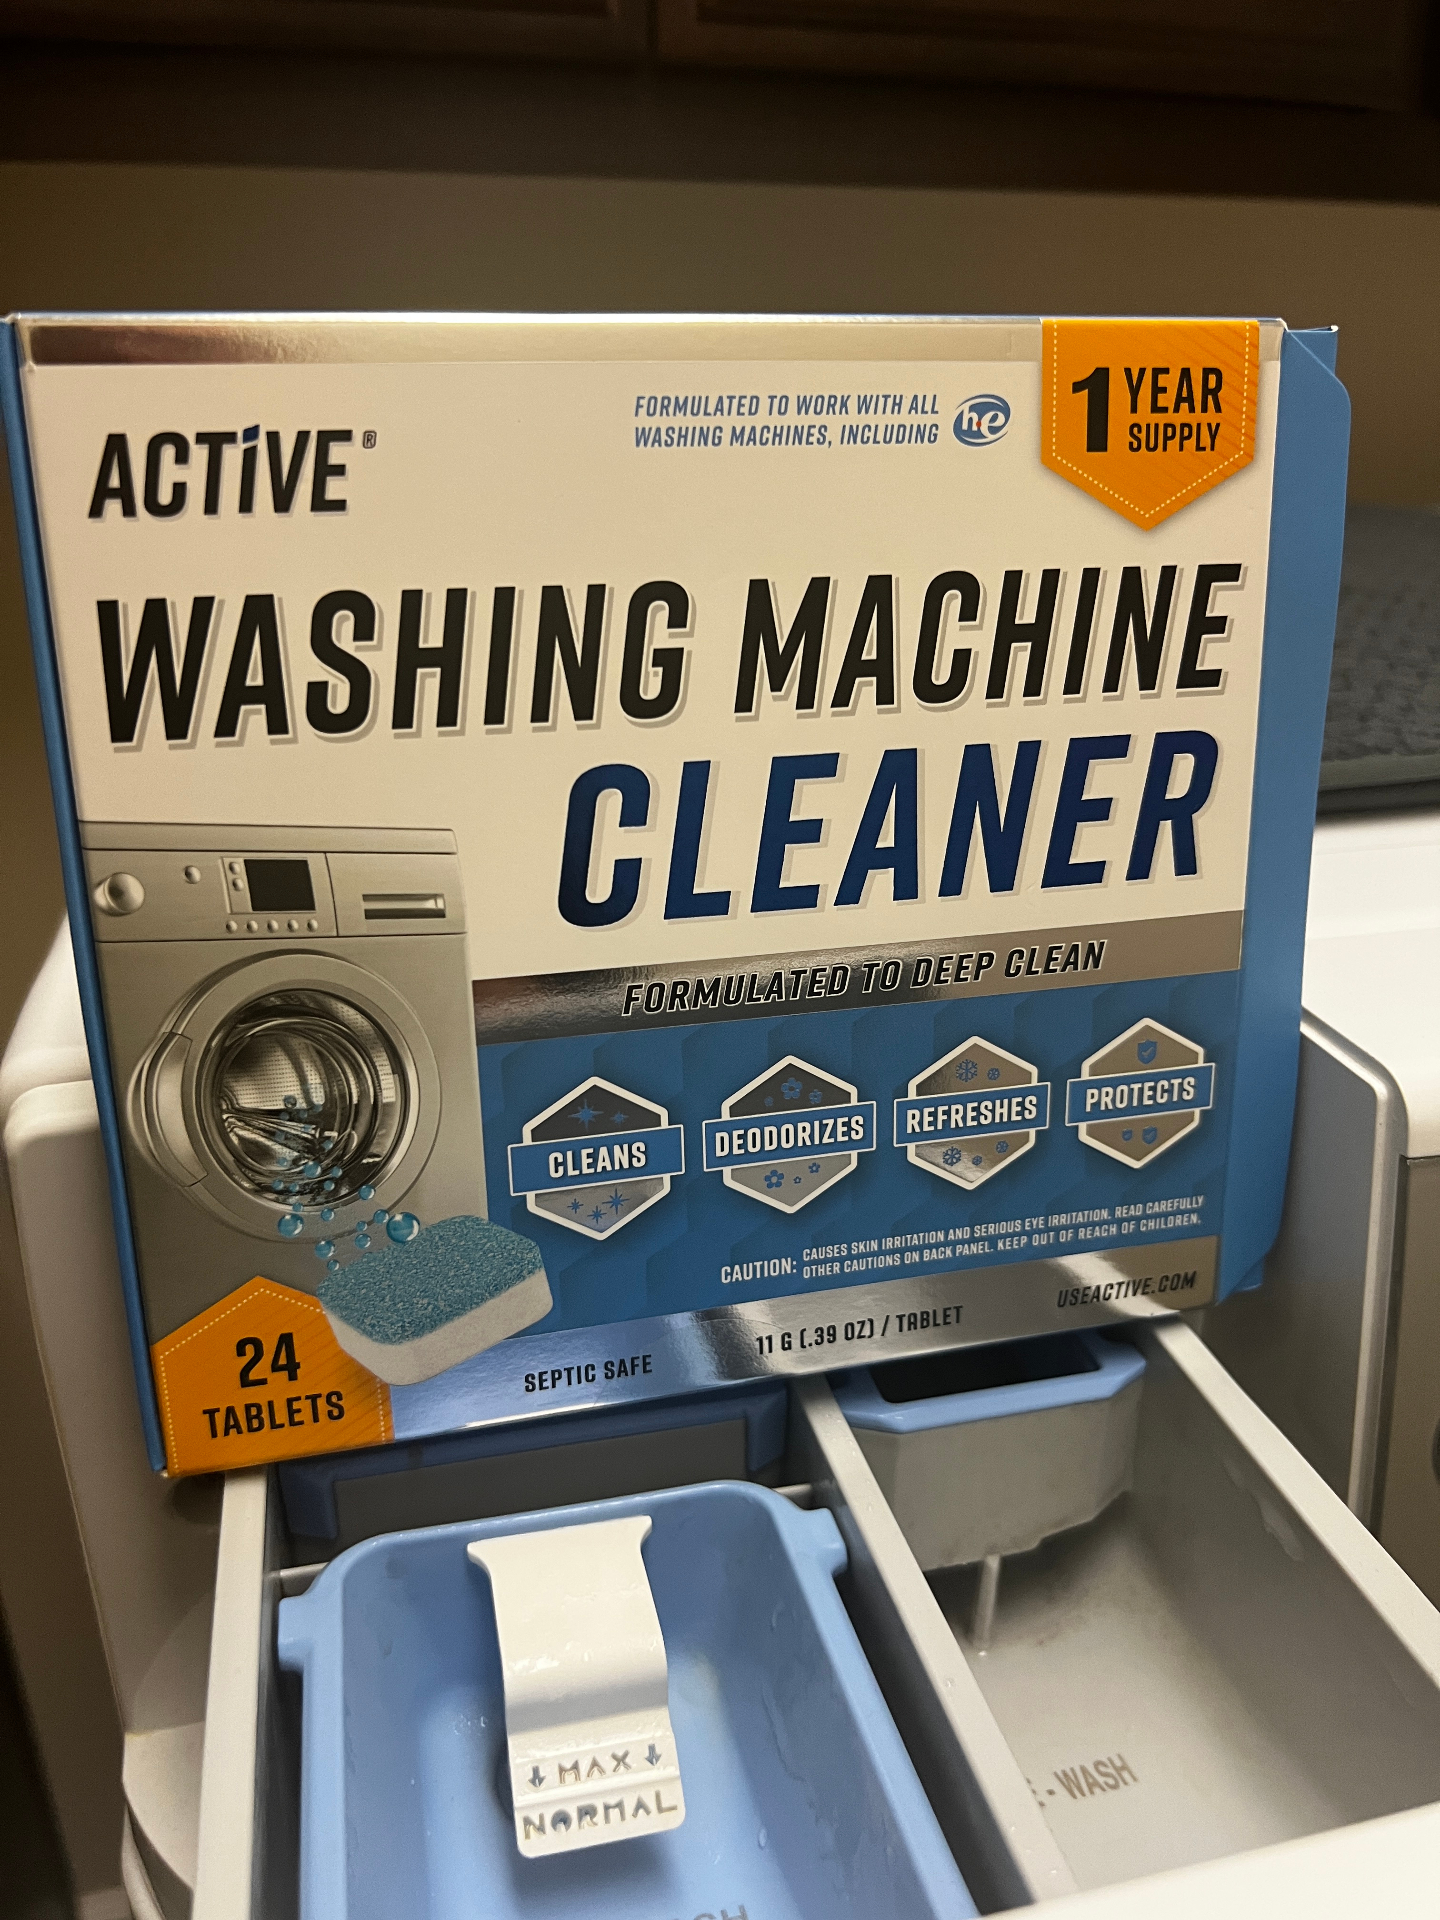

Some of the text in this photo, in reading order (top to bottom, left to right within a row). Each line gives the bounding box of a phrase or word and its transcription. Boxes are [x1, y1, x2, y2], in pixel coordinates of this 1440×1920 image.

[634, 394, 940, 417] FORMULATED TO WORK WITH ALL
[1071, 366, 1223, 453] 1 YEAR
[634, 423, 940, 448] WASHING MACHINES, INCLUDING
[1128, 422, 1221, 453] SUPPLY
[97, 563, 1243, 746] WASHING MACHINE
[557, 730, 1220, 927] CLEANER
[621, 940, 1107, 1017] FORMULATED TO DEEP CLEAN
[905, 1096, 1038, 1135] REFRESHES
[1085, 1077, 1197, 1113] PROTECTS
[714, 1115, 865, 1158] DEODORIZES
[547, 1141, 648, 1179] CLEANS
[802, 1195, 1205, 1262] CAUSES SKIN IRRITATION AND SERIOUS EYE IRRITATION. READ CAREFULLY
[802, 1212, 1202, 1279] OTHER CAUTIONS ON BACK PANEL. KEEP OUT OF REACH OF CHILDREN.
[721, 1257, 797, 1284] CAUTION:
[1056, 1270, 1198, 1308] USEACTIVE.COM
[756, 1305, 964, 1355] 11 G (.39 OZ) / TABLET
[235, 1332, 301, 1388] 24
[524, 1354, 653, 1394] SEPTIC SAFE
[202, 1390, 345, 1440] TABLETS
[558, 1749, 634, 1785] MAX
[522, 1790, 678, 1840] NORMAL
